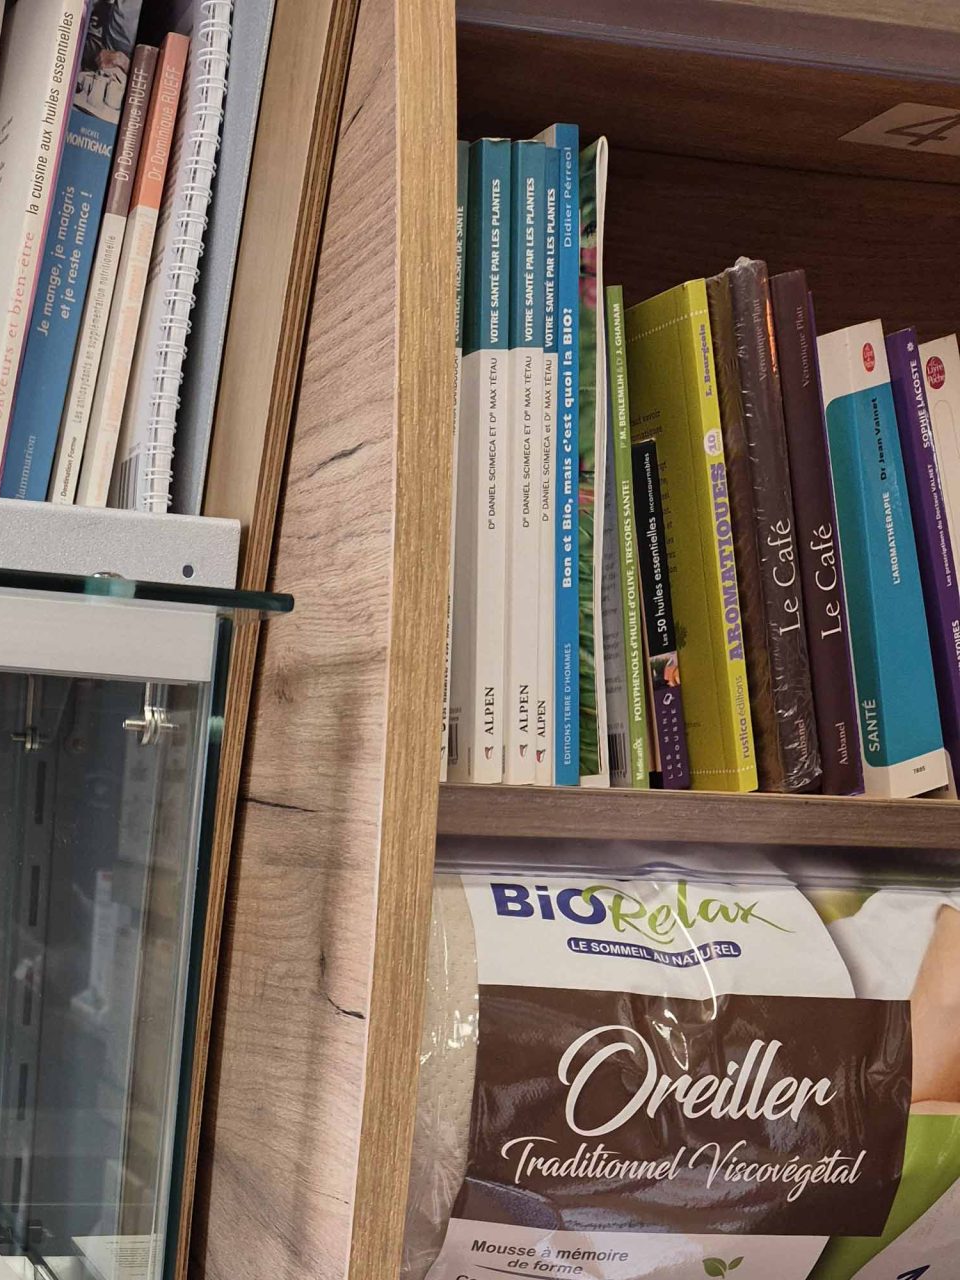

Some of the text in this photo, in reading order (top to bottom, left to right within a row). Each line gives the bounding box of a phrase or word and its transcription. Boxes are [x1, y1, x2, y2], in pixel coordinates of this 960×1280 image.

[27, 11, 74, 216] la cuisine aux huiles essentielles
[115, 67, 148, 181] Dr Dominique RUEFF
[37, 185, 76, 336] Je mange, je maigris
[61, 201, 91, 319] et je reste mince
[490, 179, 501, 343] VOTRE SANTÉ PAR LES PLANTES
[564, 201, 573, 248] Didier
[563, 307, 574, 588] Bon et Bio, mais c'est quoi la BIO?
[871, 396, 888, 481] Dr Jean Valnet
[910, 360, 931, 449] SOPHIE LACOSTE
[644, 452, 667, 633] 50 huiles essentielles incontournables
[710, 462, 745, 660] AROMATIQUES
[810, 523, 843, 641] Le Café
[485, 686, 495, 735] ALPEN
[867, 699, 880, 753] SANTÉ
[557, 1024, 836, 1138] Oreiller
[500, 1135, 681, 1191] Traditionnel
[471, 1239, 629, 1263] Mousse à mémoire
[507, 1257, 584, 1276] de forme
